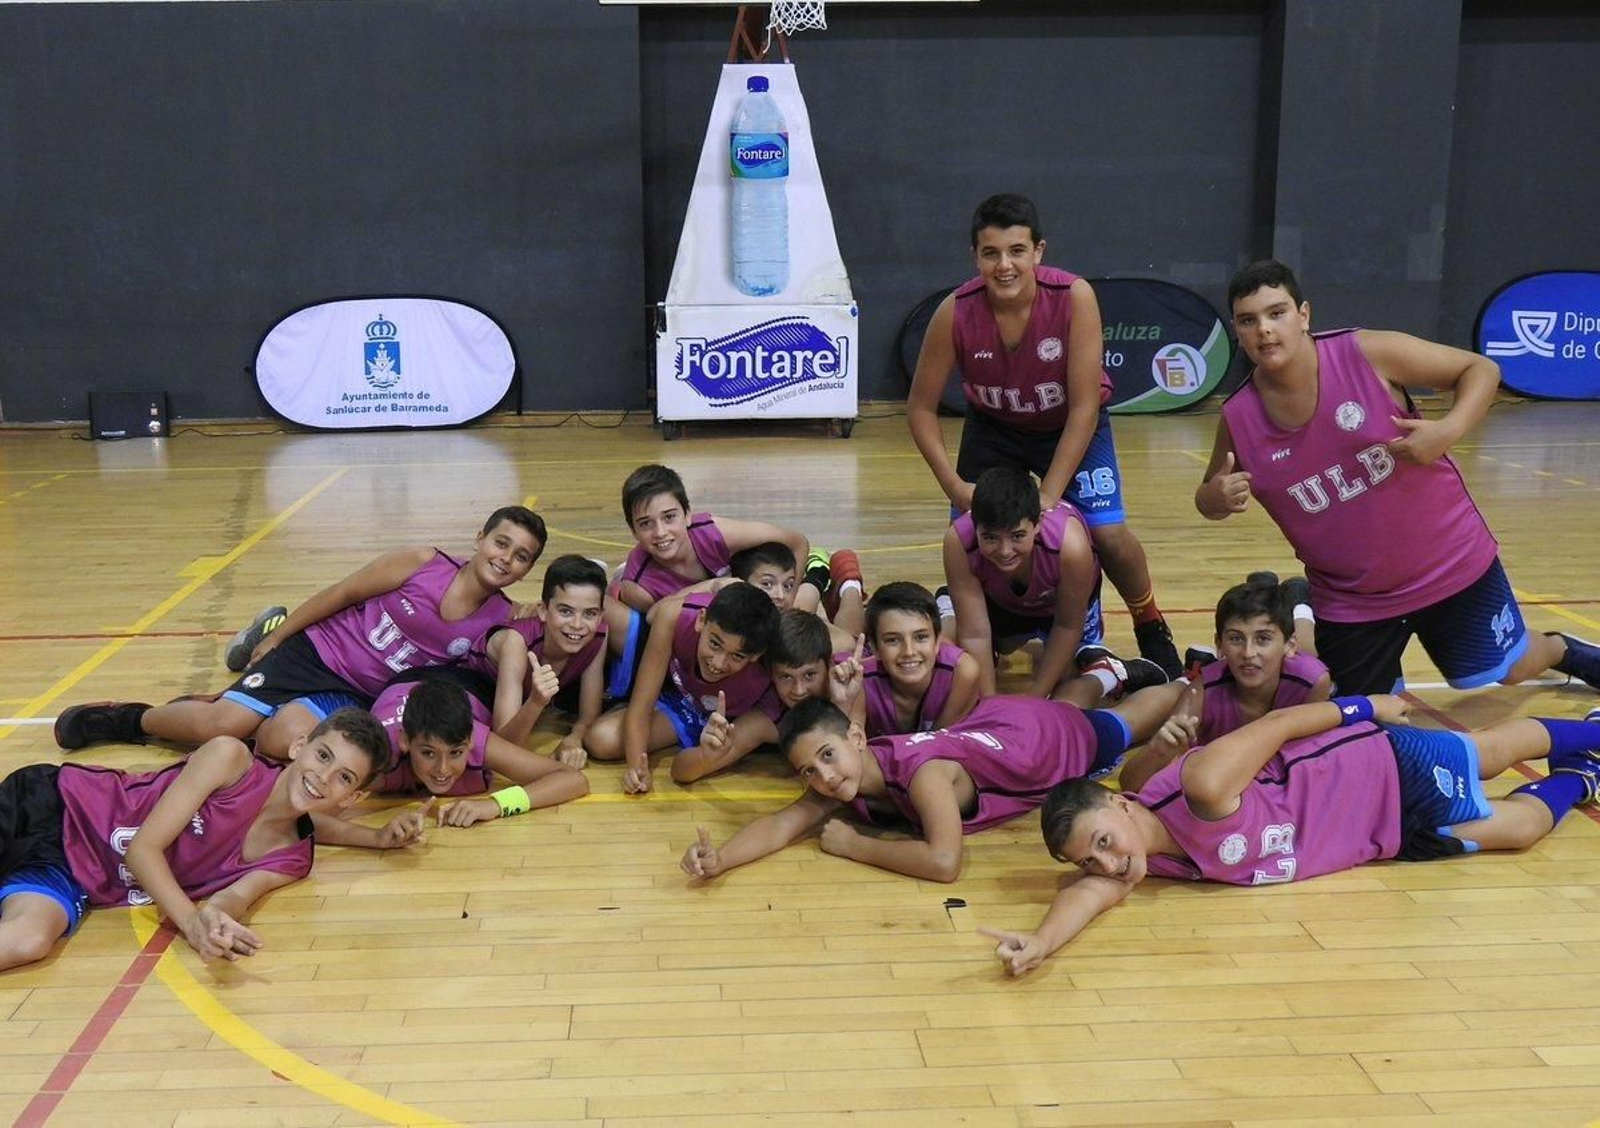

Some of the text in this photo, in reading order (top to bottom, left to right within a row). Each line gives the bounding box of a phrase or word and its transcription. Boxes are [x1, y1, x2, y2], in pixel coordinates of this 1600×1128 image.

[736, 147, 786, 160] Fontarel
[675, 336, 849, 380] Fontarel
[1101, 350, 1124, 367] to
[1562, 339, 1586, 359] de
[341, 391, 430, 403] Ayuntamiento de
[757, 400, 774, 412] Agua
[973, 381, 1067, 413] ULB
[325, 403, 449, 415] Sanlúcar de Barrameda
[1075, 466, 1116, 499] 16
[1286, 443, 1395, 514] ULB
[368, 611, 438, 674] UL
